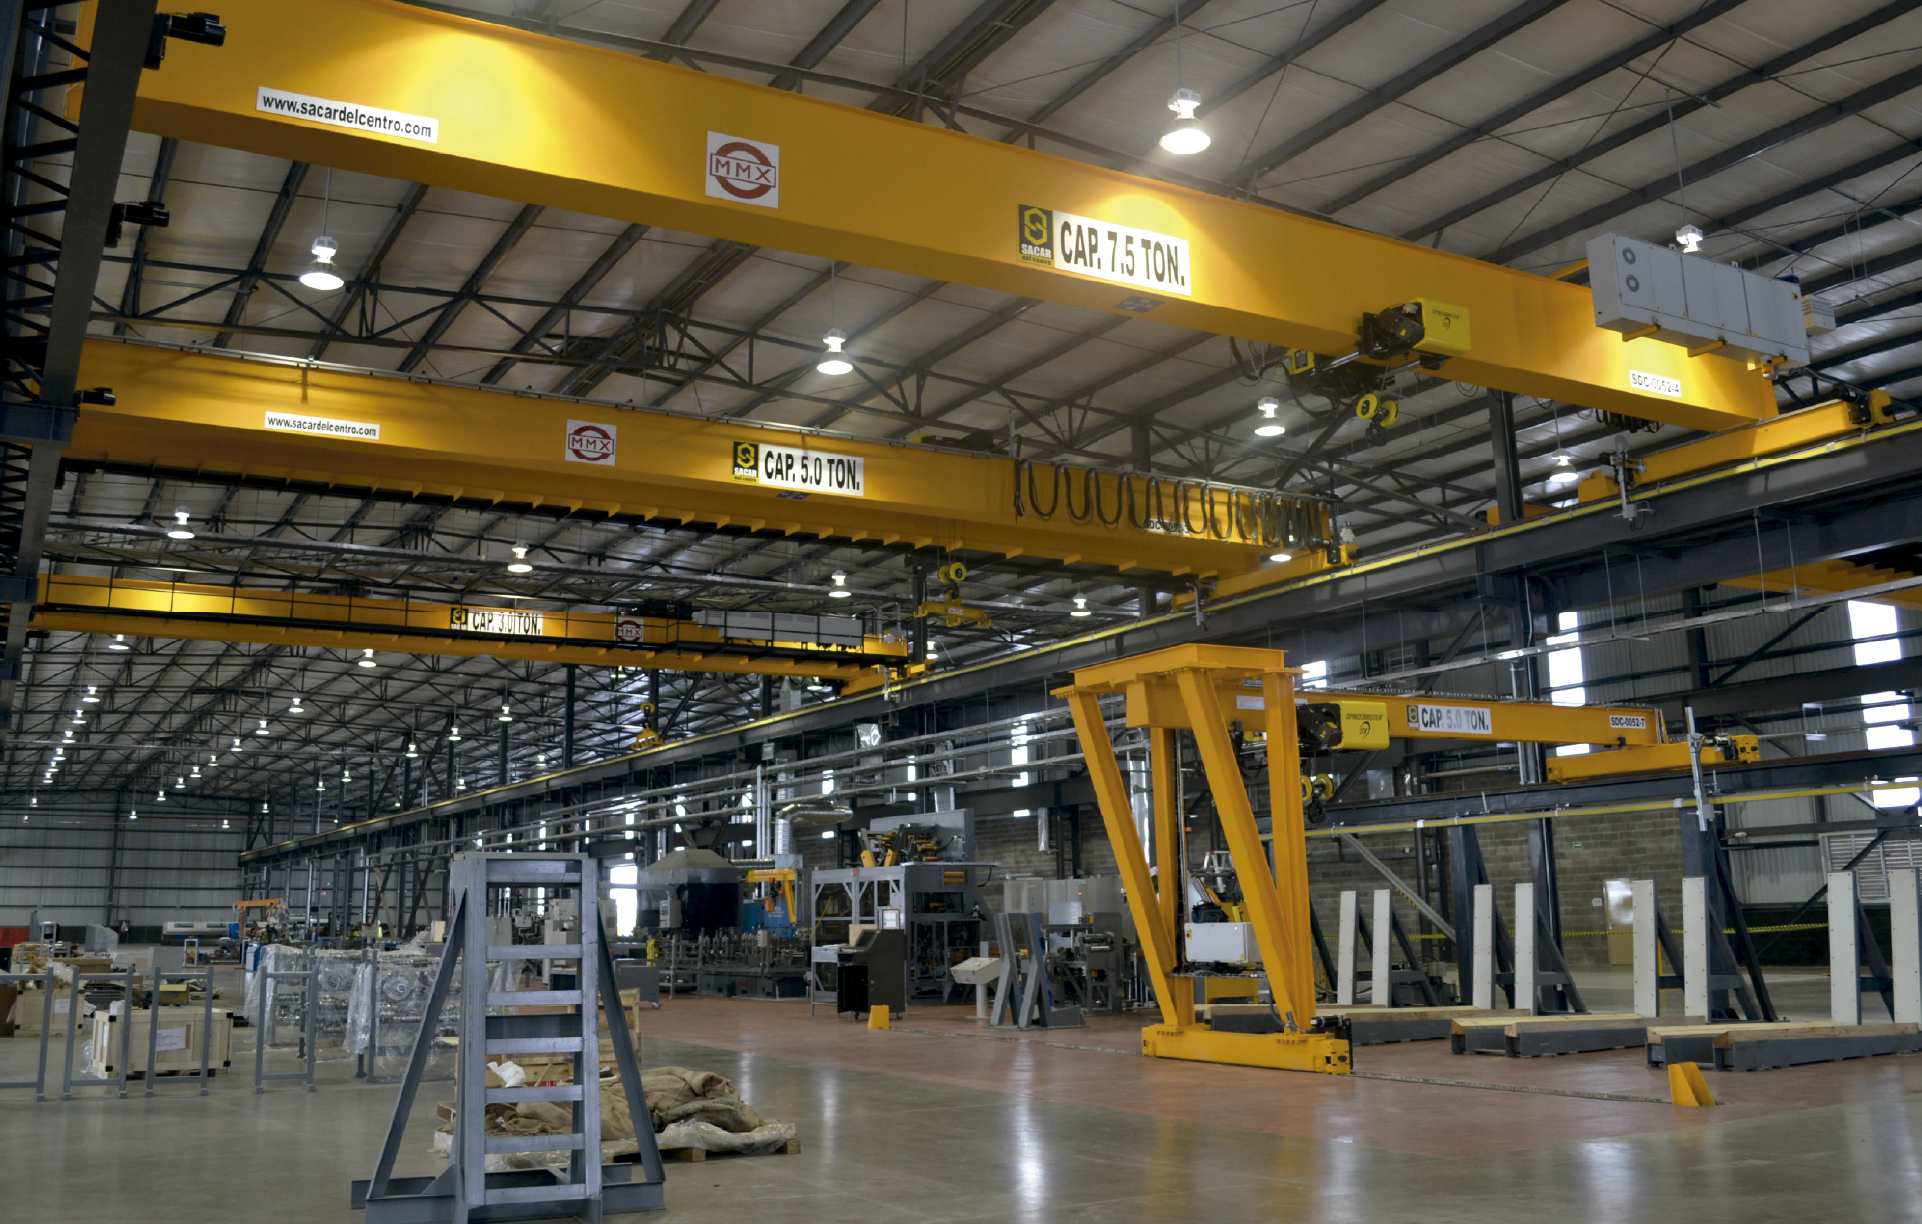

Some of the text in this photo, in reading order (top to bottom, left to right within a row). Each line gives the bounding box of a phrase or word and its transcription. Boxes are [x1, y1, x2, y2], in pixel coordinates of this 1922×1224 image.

[263, 95, 431, 138] www.sacardelcentro.com
[715, 157, 771, 184] MMX
[1021, 243, 1052, 259] SACAR
[1060, 220, 1185, 286] CAP. 7.5 TON.
[267, 416, 376, 437] www.sacardelcentro.com
[571, 436, 611, 452] MMX
[734, 467, 757, 478] SACAR
[764, 450, 860, 491] CAP. 5.0 TON.
[472, 611, 541, 635] CAP. 3.0 TON.
[617, 628, 641, 637] MMX
[1421, 707, 1489, 731] CAP. 5.0 TON.
